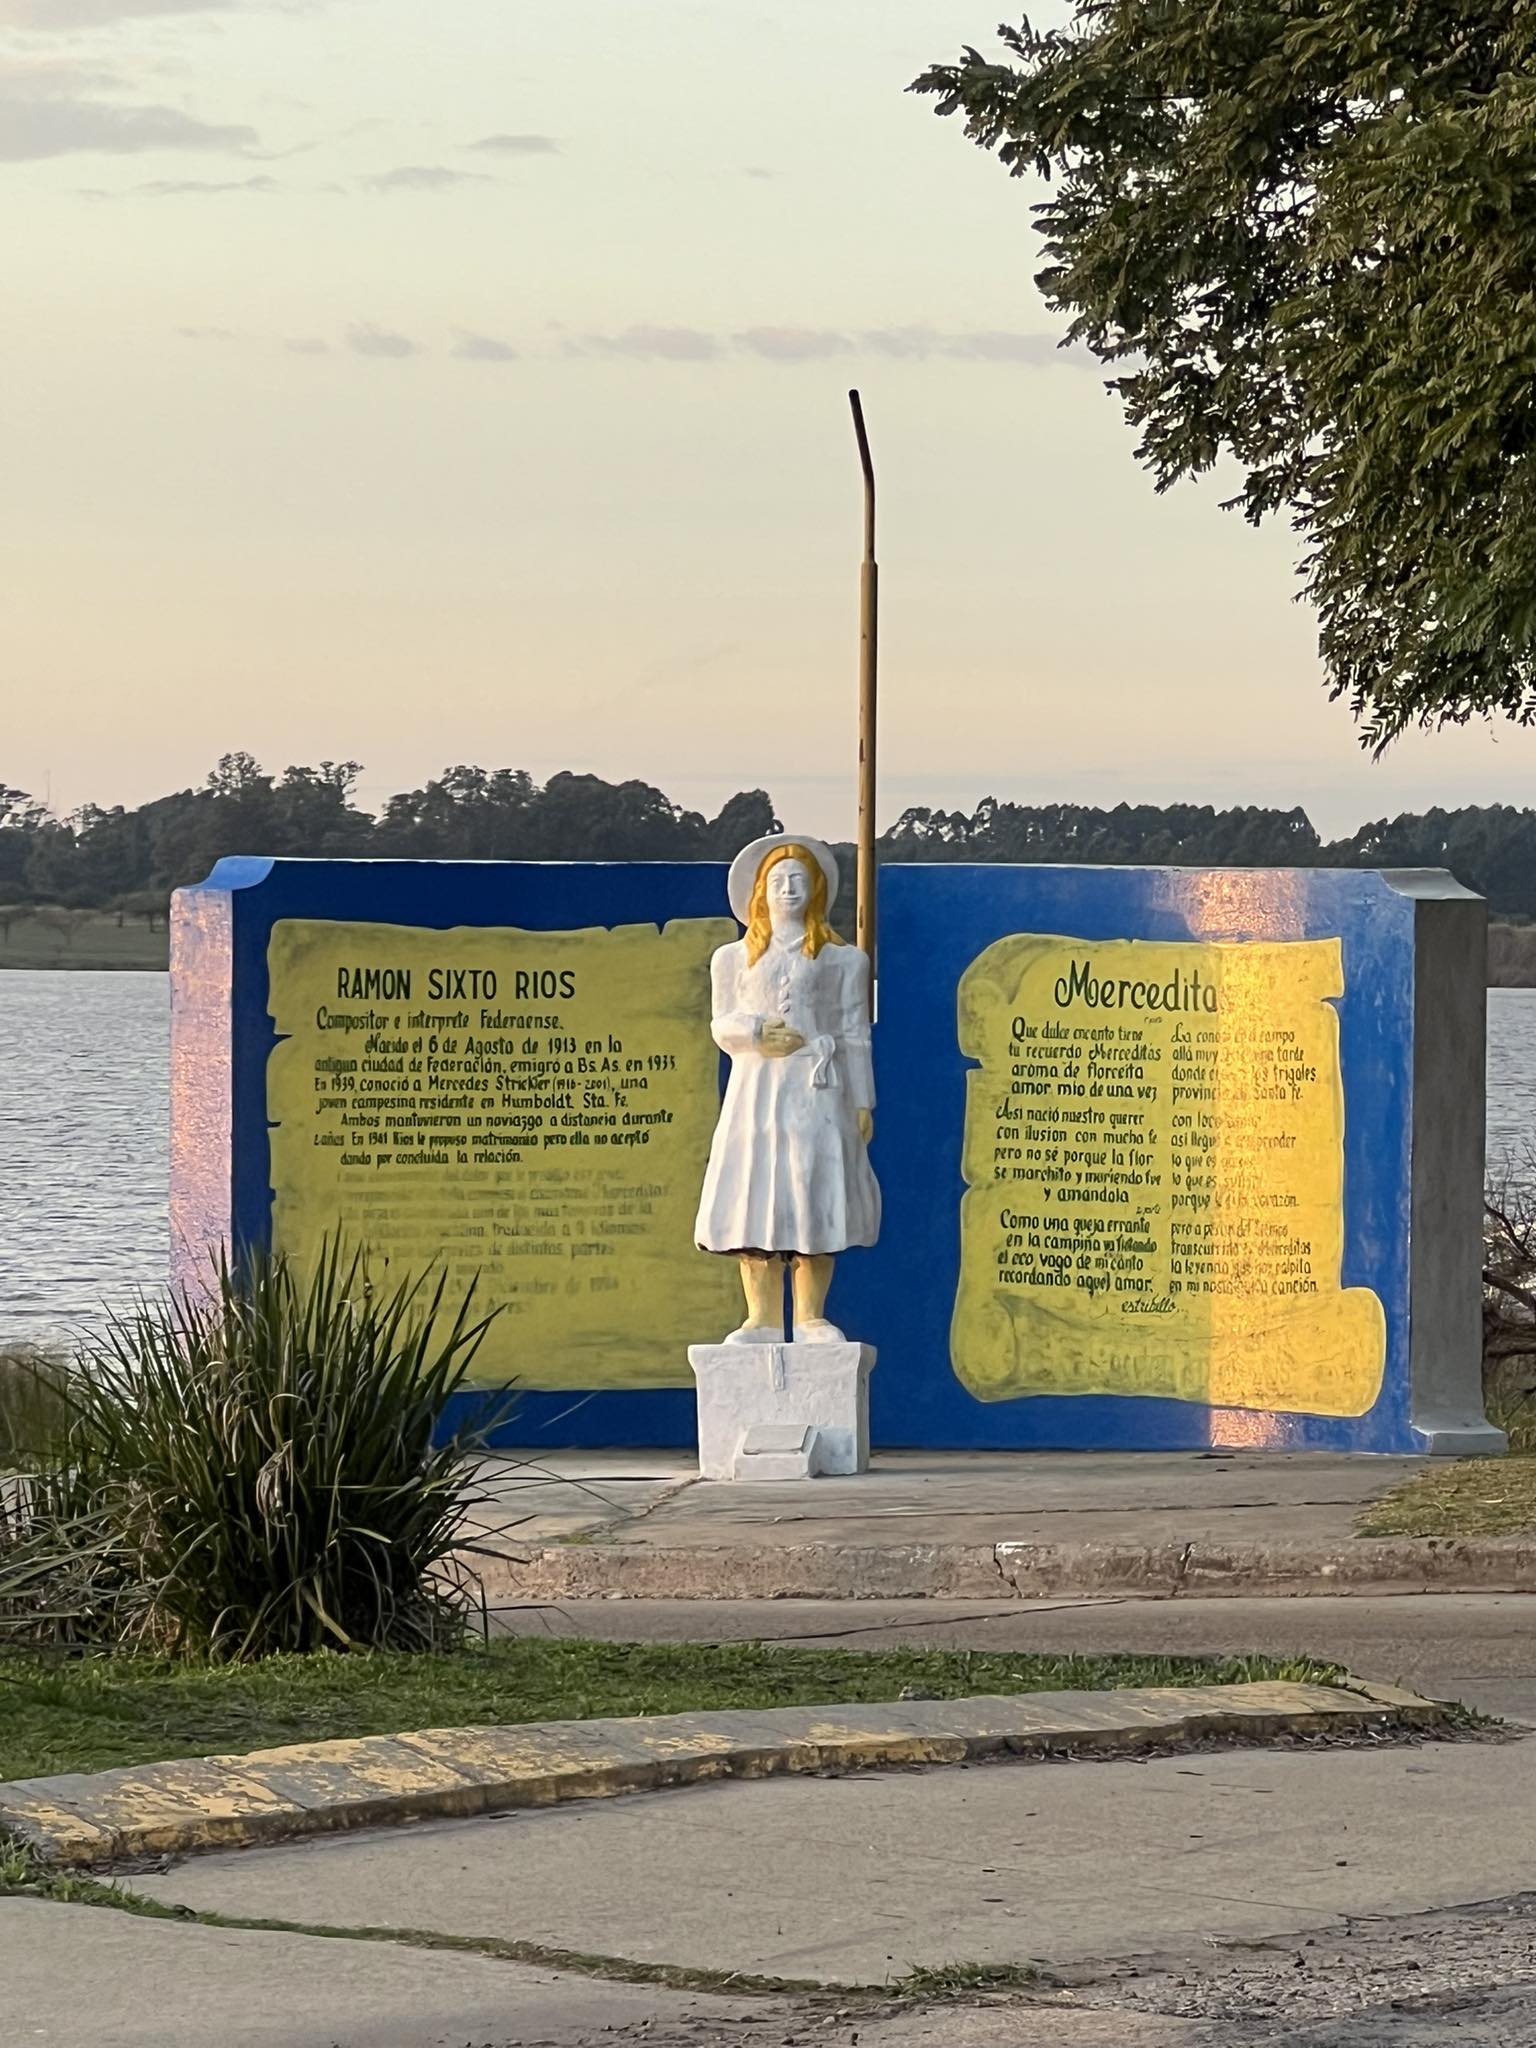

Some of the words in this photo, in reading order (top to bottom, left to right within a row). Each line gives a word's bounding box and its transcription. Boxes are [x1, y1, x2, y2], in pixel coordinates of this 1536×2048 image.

[338, 967, 411, 1000] RAMON
[428, 968, 497, 1000] SIXTO
[515, 970, 575, 999] RIOS
[316, 1006, 389, 1034] Compositor
[394, 1015, 401, 1029] e
[480, 1009, 564, 1030] Federaense.
[1012, 1016, 1037, 1043] Que
[1041, 1020, 1070, 1041] dulce
[1073, 1026, 1115, 1042] encanto
[1118, 1025, 1143, 1042] tiene
[1170, 1022, 1192, 1044] La
[1258, 1029, 1296, 1046] campo
[365, 1033, 409, 1055] Nacido
[412, 1037, 422, 1054] el
[428, 1035, 438, 1053] 6
[442, 1037, 457, 1054] de
[464, 1036, 514, 1059] Agosto
[522, 1037, 538, 1054] de
[548, 1037, 577, 1054] 1913
[585, 1040, 602, 1054] en
[608, 1034, 623, 1053] la
[1009, 1041, 1020, 1058] tu
[1026, 1043, 1082, 1060] recuerdo
[1172, 1045, 1193, 1062] allá
[1195, 1050, 1219, 1065] muy
[1277, 1046, 1305, 1062] tarde
[314, 1056, 357, 1075] antigua
[361, 1055, 404, 1073] ciudad
[408, 1057, 422, 1073] de
[510, 1058, 561, 1077] emigró
[564, 1061, 573, 1074] a
[625, 1059, 643, 1072] en
[1011, 1063, 1058, 1079] aroma
[1063, 1061, 1080, 1079] de
[1171, 1064, 1206, 1081] donde
[1273, 1063, 1317, 1087] trigales
[314, 1077, 326, 1092] En
[360, 1076, 409, 1092] conoció
[413, 1080, 422, 1091] a
[428, 1075, 489, 1092] Mercedes
[620, 1076, 648, 1090] una
[1011, 1081, 1051, 1096] amor
[1089, 1081, 1103, 1098] de
[1106, 1084, 1134, 1099] una
[1137, 1086, 1158, 1103] vez
[1252, 1085, 1287, 1101] Santa
[315, 1097, 347, 1115] joven
[351, 1097, 417, 1114] campesina
[419, 1094, 474, 1110] residente
[480, 1097, 495, 1110] en
[340, 1112, 380, 1128] Ambos
[385, 1112, 461, 1128] mantuvieron
[467, 1115, 482, 1127] un
[486, 1113, 543, 1133] noviazgo
[550, 1115, 558, 1127] a
[561, 1112, 617, 1127] distancia
[622, 1108, 674, 1126] durante
[1026, 1107, 1060, 1123] nació
[1061, 1106, 1106, 1125] nuestro
[1109, 1113, 1145, 1130] querer
[1172, 1114, 1193, 1128] con
[351, 1131, 364, 1146] En
[417, 1131, 426, 1145] le
[429, 1134, 467, 1149] propuso
[471, 1131, 539, 1146] matrimonio
[543, 1133, 568, 1150] pero
[569, 1130, 590, 1146] ella
[594, 1133, 608, 1145] no
[610, 1128, 651, 1149] aceptó
[997, 1125, 1019, 1140] con
[1075, 1130, 1098, 1143] con
[1103, 1129, 1144, 1145] mucha
[1148, 1128, 1158, 1146] fe
[1171, 1131, 1188, 1147] asi
[340, 1150, 371, 1166] dando
[377, 1152, 392, 1169] por
[395, 1149, 449, 1165] concluida
[456, 1149, 468, 1164] la
[473, 1149, 524, 1164] relación.
[994, 1146, 1022, 1163] pero
[1026, 1148, 1041, 1162] no
[1045, 1145, 1059, 1163] sé
[1064, 1150, 1107, 1168] porque
[1112, 1148, 1125, 1166] la
[1129, 1148, 1154, 1167] flor
[1172, 1153, 1182, 1168] lo
[1185, 1156, 1204, 1173] que
[1206, 1155, 1217, 1168] es
[993, 1165, 1007, 1180] se
[1075, 1172, 1084, 1185] y
[1145, 1168, 1162, 1186] fue
[1172, 1171, 1182, 1187] lo
[1185, 1175, 1205, 1191] que
[1205, 1175, 1218, 1188] es
[1043, 1186, 1052, 1202] y
[1171, 1193, 1212, 1214] porque
[562, 1223, 572, 1237] a
[1000, 1208, 1040, 1229] Como
[1043, 1216, 1069, 1232] una
[1073, 1217, 1105, 1237] queja
[1107, 1216, 1151, 1234] errante
[1171, 1222, 1193, 1239] pero
[1194, 1223, 1202, 1236] a
[1006, 1233, 1023, 1248] en
[1028, 1232, 1041, 1248] la
[1044, 1235, 1101, 1254] campiña
[997, 1250, 1009, 1265] el
[1011, 1252, 1034, 1266] eco
[1039, 1252, 1073, 1273] vago
[1076, 1252, 1091, 1270] de
[1094, 1256, 1108, 1269] mi
[1171, 1258, 1182, 1275] la
[998, 1266, 1072, 1287] recordando
[1076, 1272, 1111, 1298] aquel
[1169, 1279, 1182, 1294] en
[1186, 1280, 1200, 1293] mi
[1271, 1276, 1319, 1295] canción.
